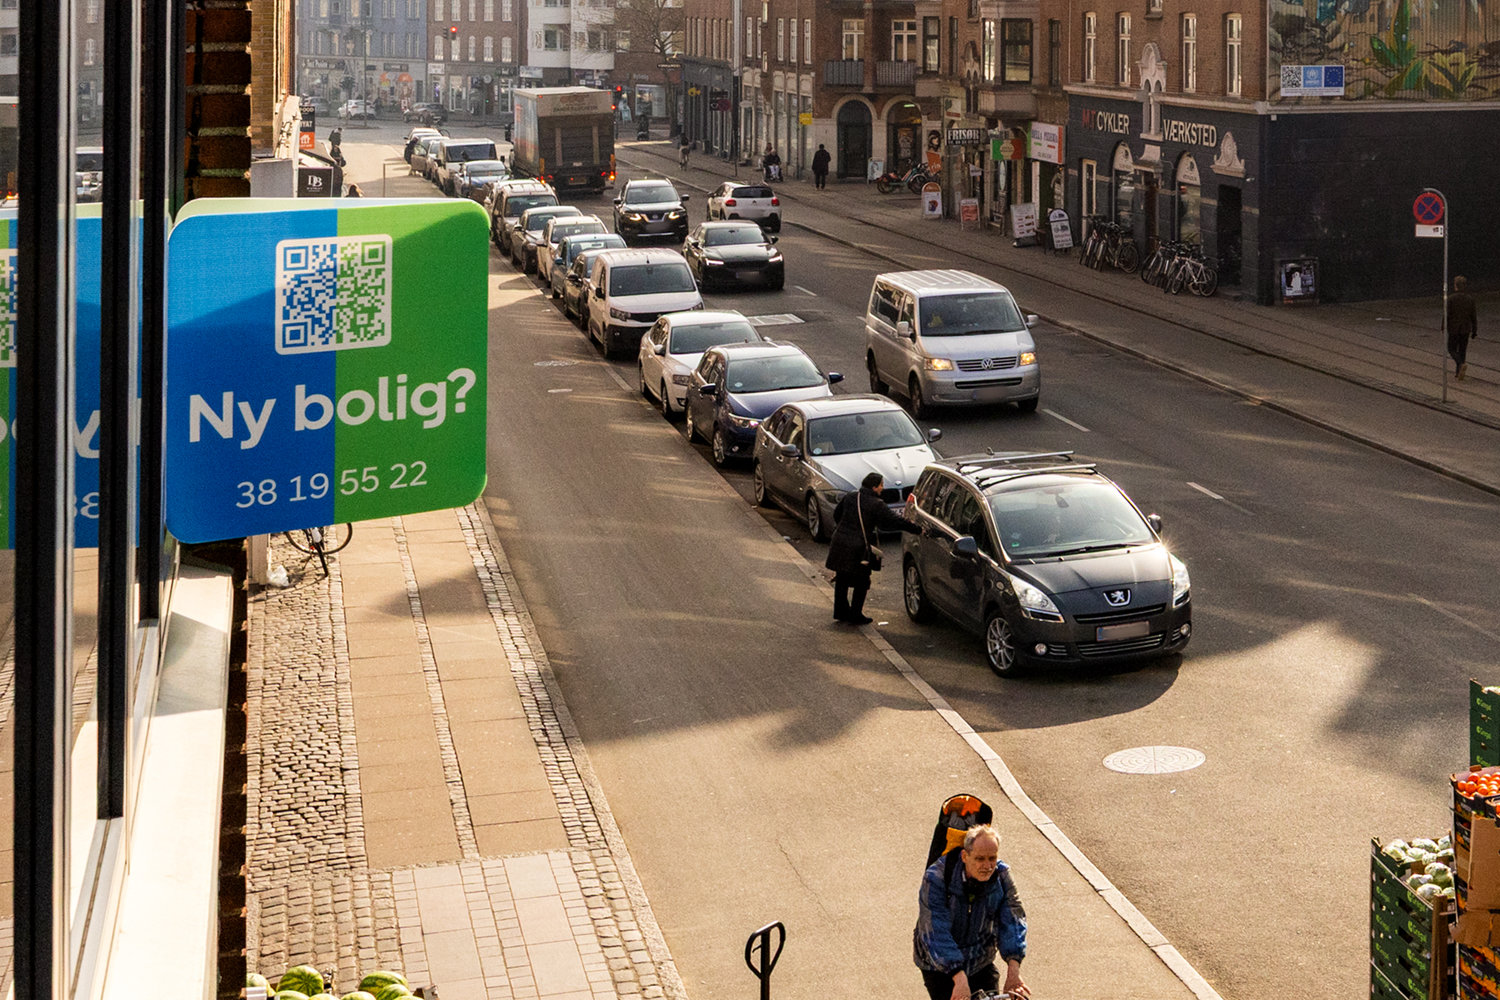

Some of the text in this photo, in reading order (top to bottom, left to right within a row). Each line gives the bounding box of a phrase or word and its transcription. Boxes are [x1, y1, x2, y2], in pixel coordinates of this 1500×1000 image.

[947, 129, 980, 140] FRISØR
[1096, 111, 1130, 135] CYKLER
[1163, 119, 1217, 148] VÆRKSTED
[189, 368, 477, 450] Ny bolig?
[235, 460, 428, 508] 38 19 55 22
